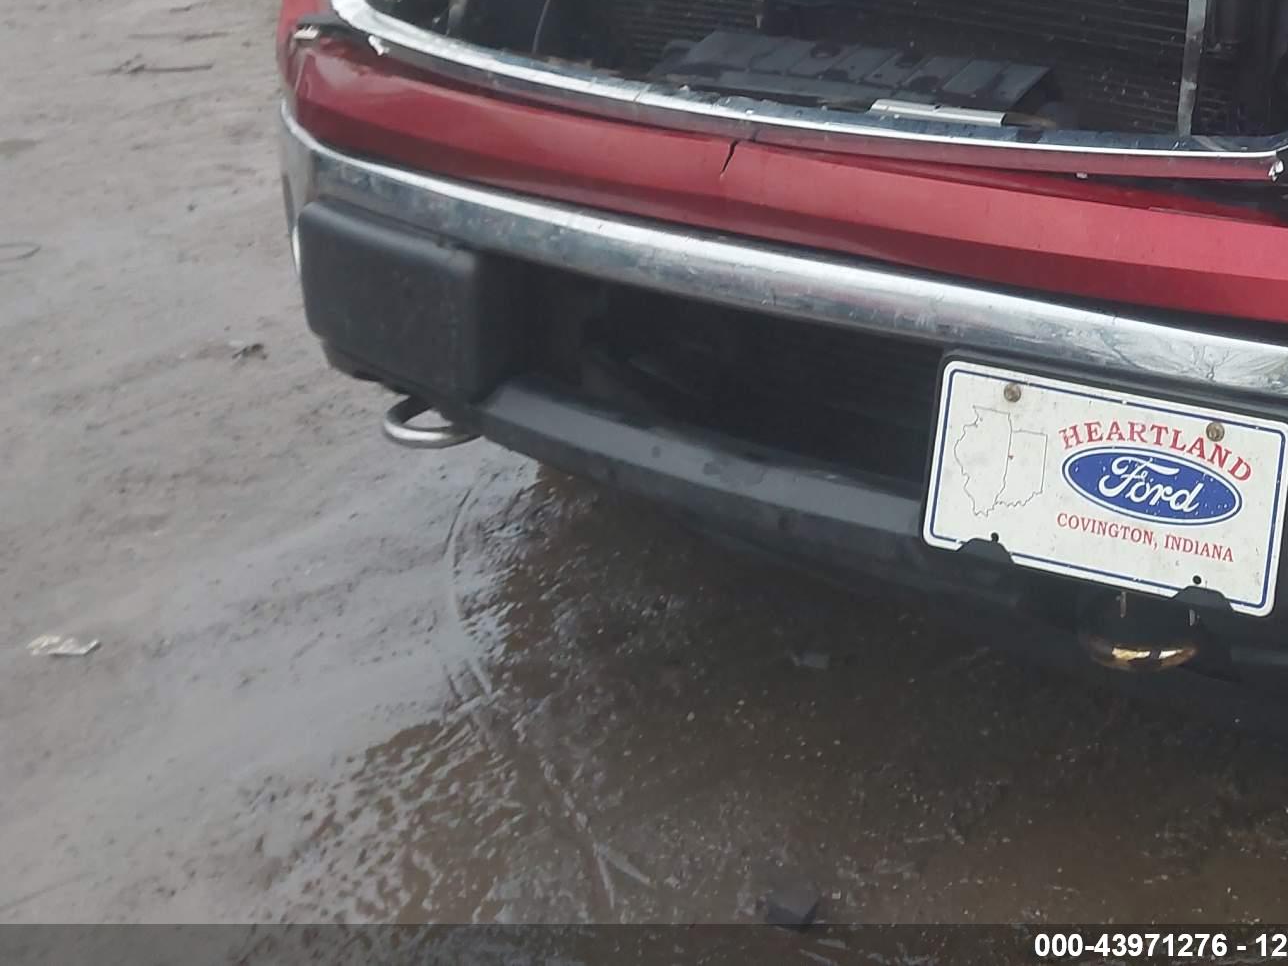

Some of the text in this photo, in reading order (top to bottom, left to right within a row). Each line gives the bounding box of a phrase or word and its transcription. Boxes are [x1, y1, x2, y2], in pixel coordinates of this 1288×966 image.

[1060, 421, 1252, 482] HEARTLAND
[1098, 456, 1202, 513] Ford
[1057, 513, 1233, 562] COVINGTON, INDIANA
